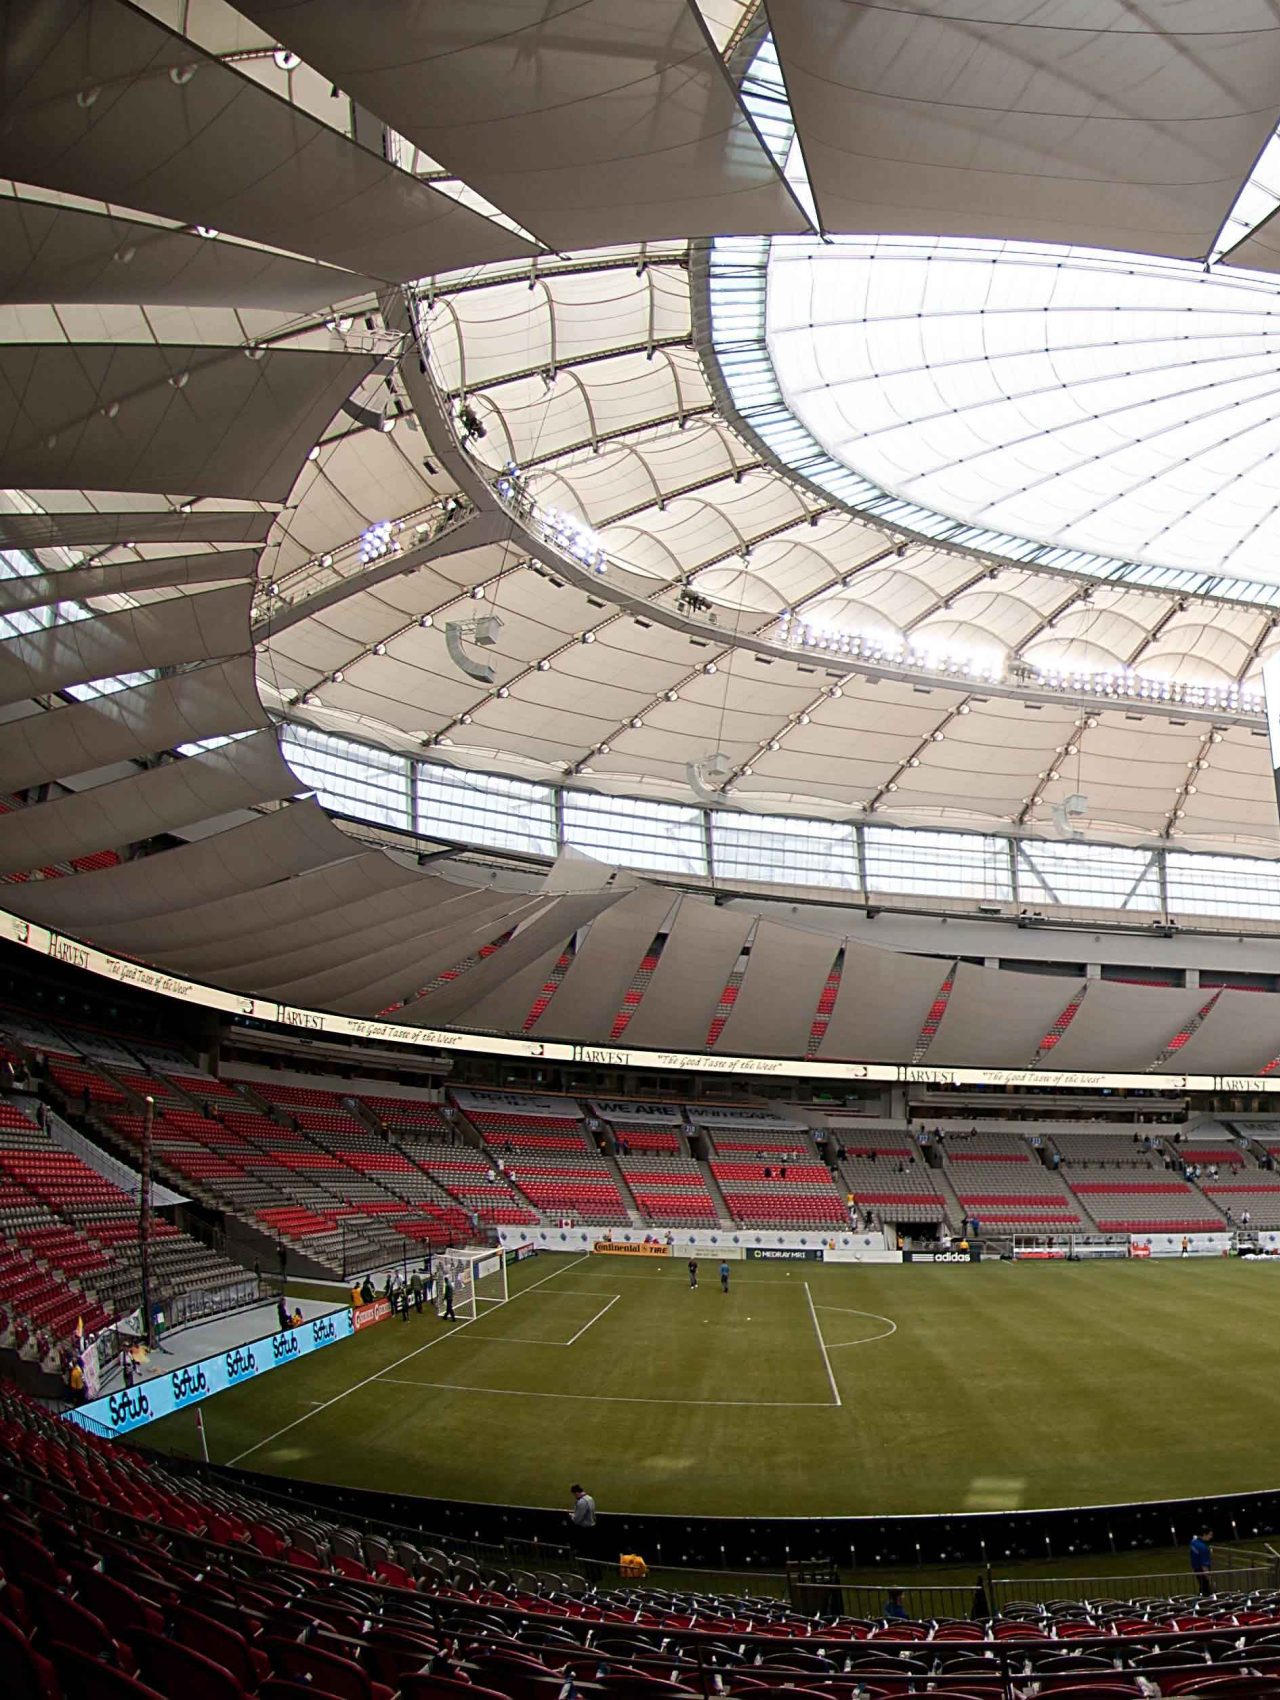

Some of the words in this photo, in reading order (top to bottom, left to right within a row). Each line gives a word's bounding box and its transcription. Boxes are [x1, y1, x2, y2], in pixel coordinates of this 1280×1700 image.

[49, 932, 90, 969] HARVEST
[277, 1003, 326, 1030] HARVEST
[367, 1023, 386, 1036] Good
[573, 1045, 632, 1065] HARVEST
[680, 1056, 700, 1068] Good
[728, 1060, 739, 1072] of
[741, 1060, 754, 1070] the
[898, 1067, 956, 1082] HARVEST
[1214, 1077, 1268, 1091] HARVEST
[597, 1103, 630, 1114] WE
[634, 1104, 676, 1116] ARE
[594, 1242, 641, 1253] Continental
[935, 1253, 971, 1262] adidas
[273, 1332, 299, 1358] Softub
[226, 1347, 256, 1378] Softub
[173, 1366, 208, 1399] Softub
[110, 1388, 150, 1426] Softub
